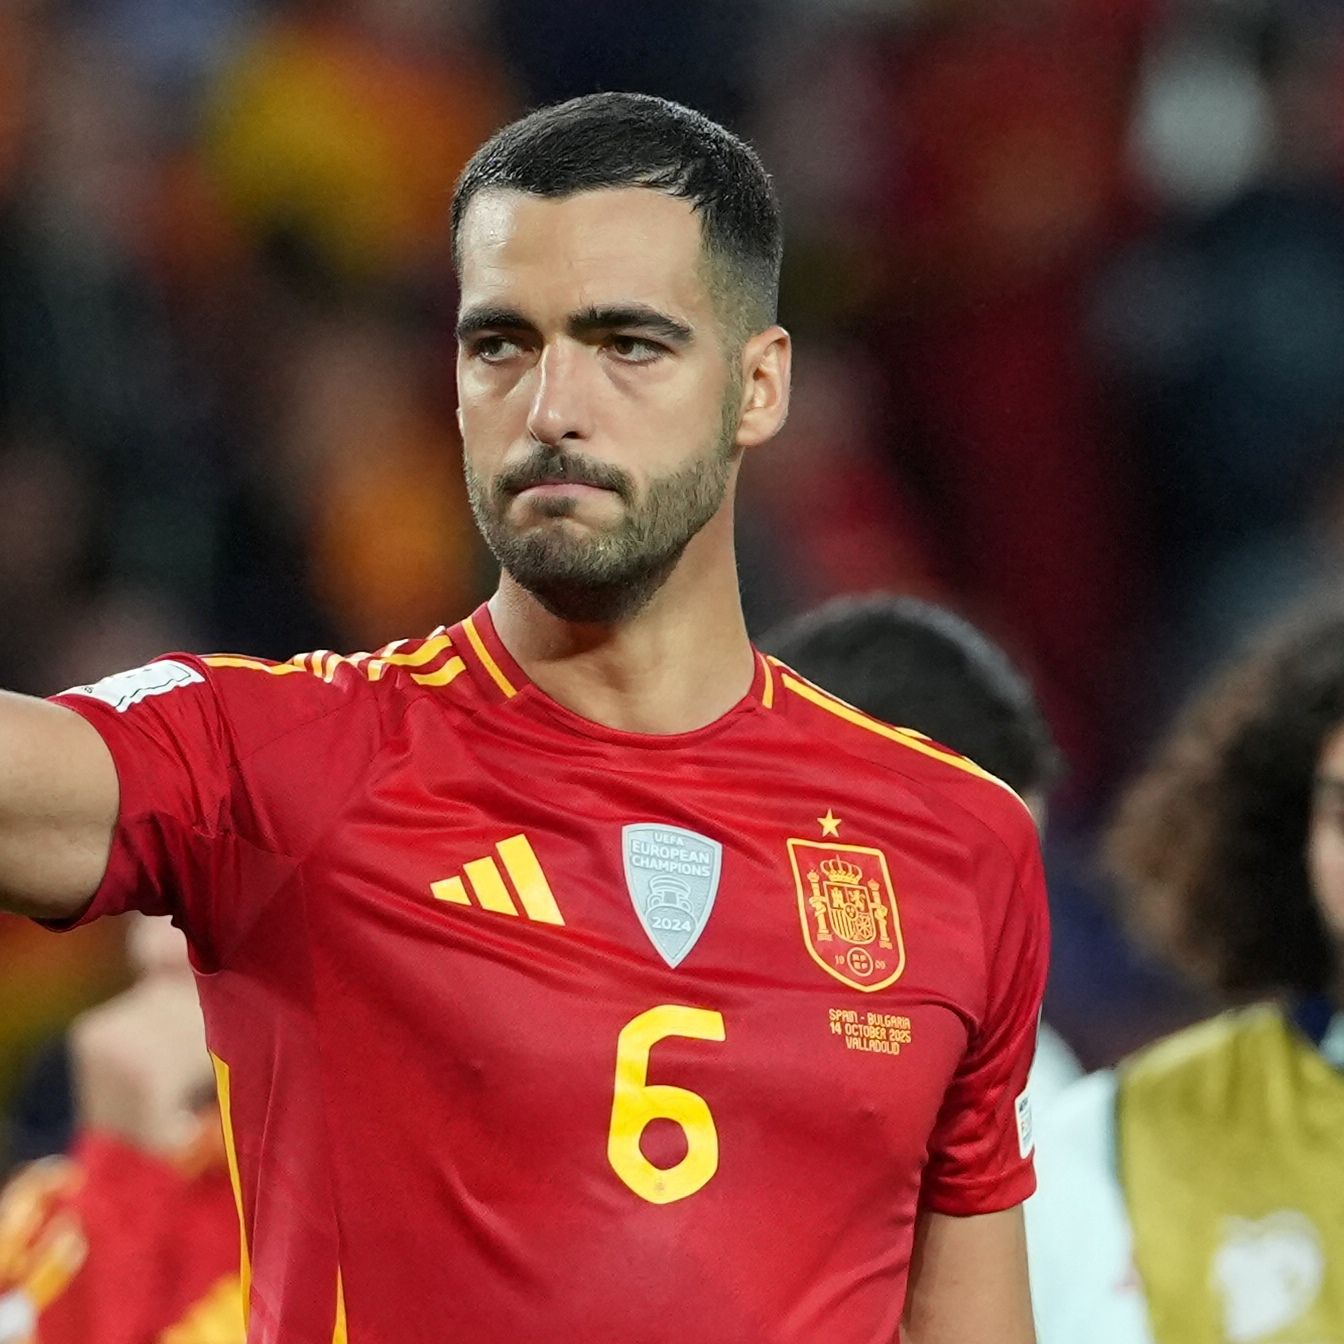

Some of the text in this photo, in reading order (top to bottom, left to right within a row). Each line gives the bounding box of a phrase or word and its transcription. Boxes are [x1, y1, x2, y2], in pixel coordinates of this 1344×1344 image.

[654, 832, 685, 846] UEFA
[631, 840, 710, 864] EUROPEAN
[631, 855, 711, 877] CHAMPIONS
[651, 916, 692, 932] 2024
[828, 1008, 858, 1023] SPAIN
[867, 1012, 911, 1029] BULGARIA
[830, 1021, 911, 1044] 14 OCTOBER 2025
[845, 1036, 900, 1055] VALLADOLID
[607, 1004, 726, 1204] 6
